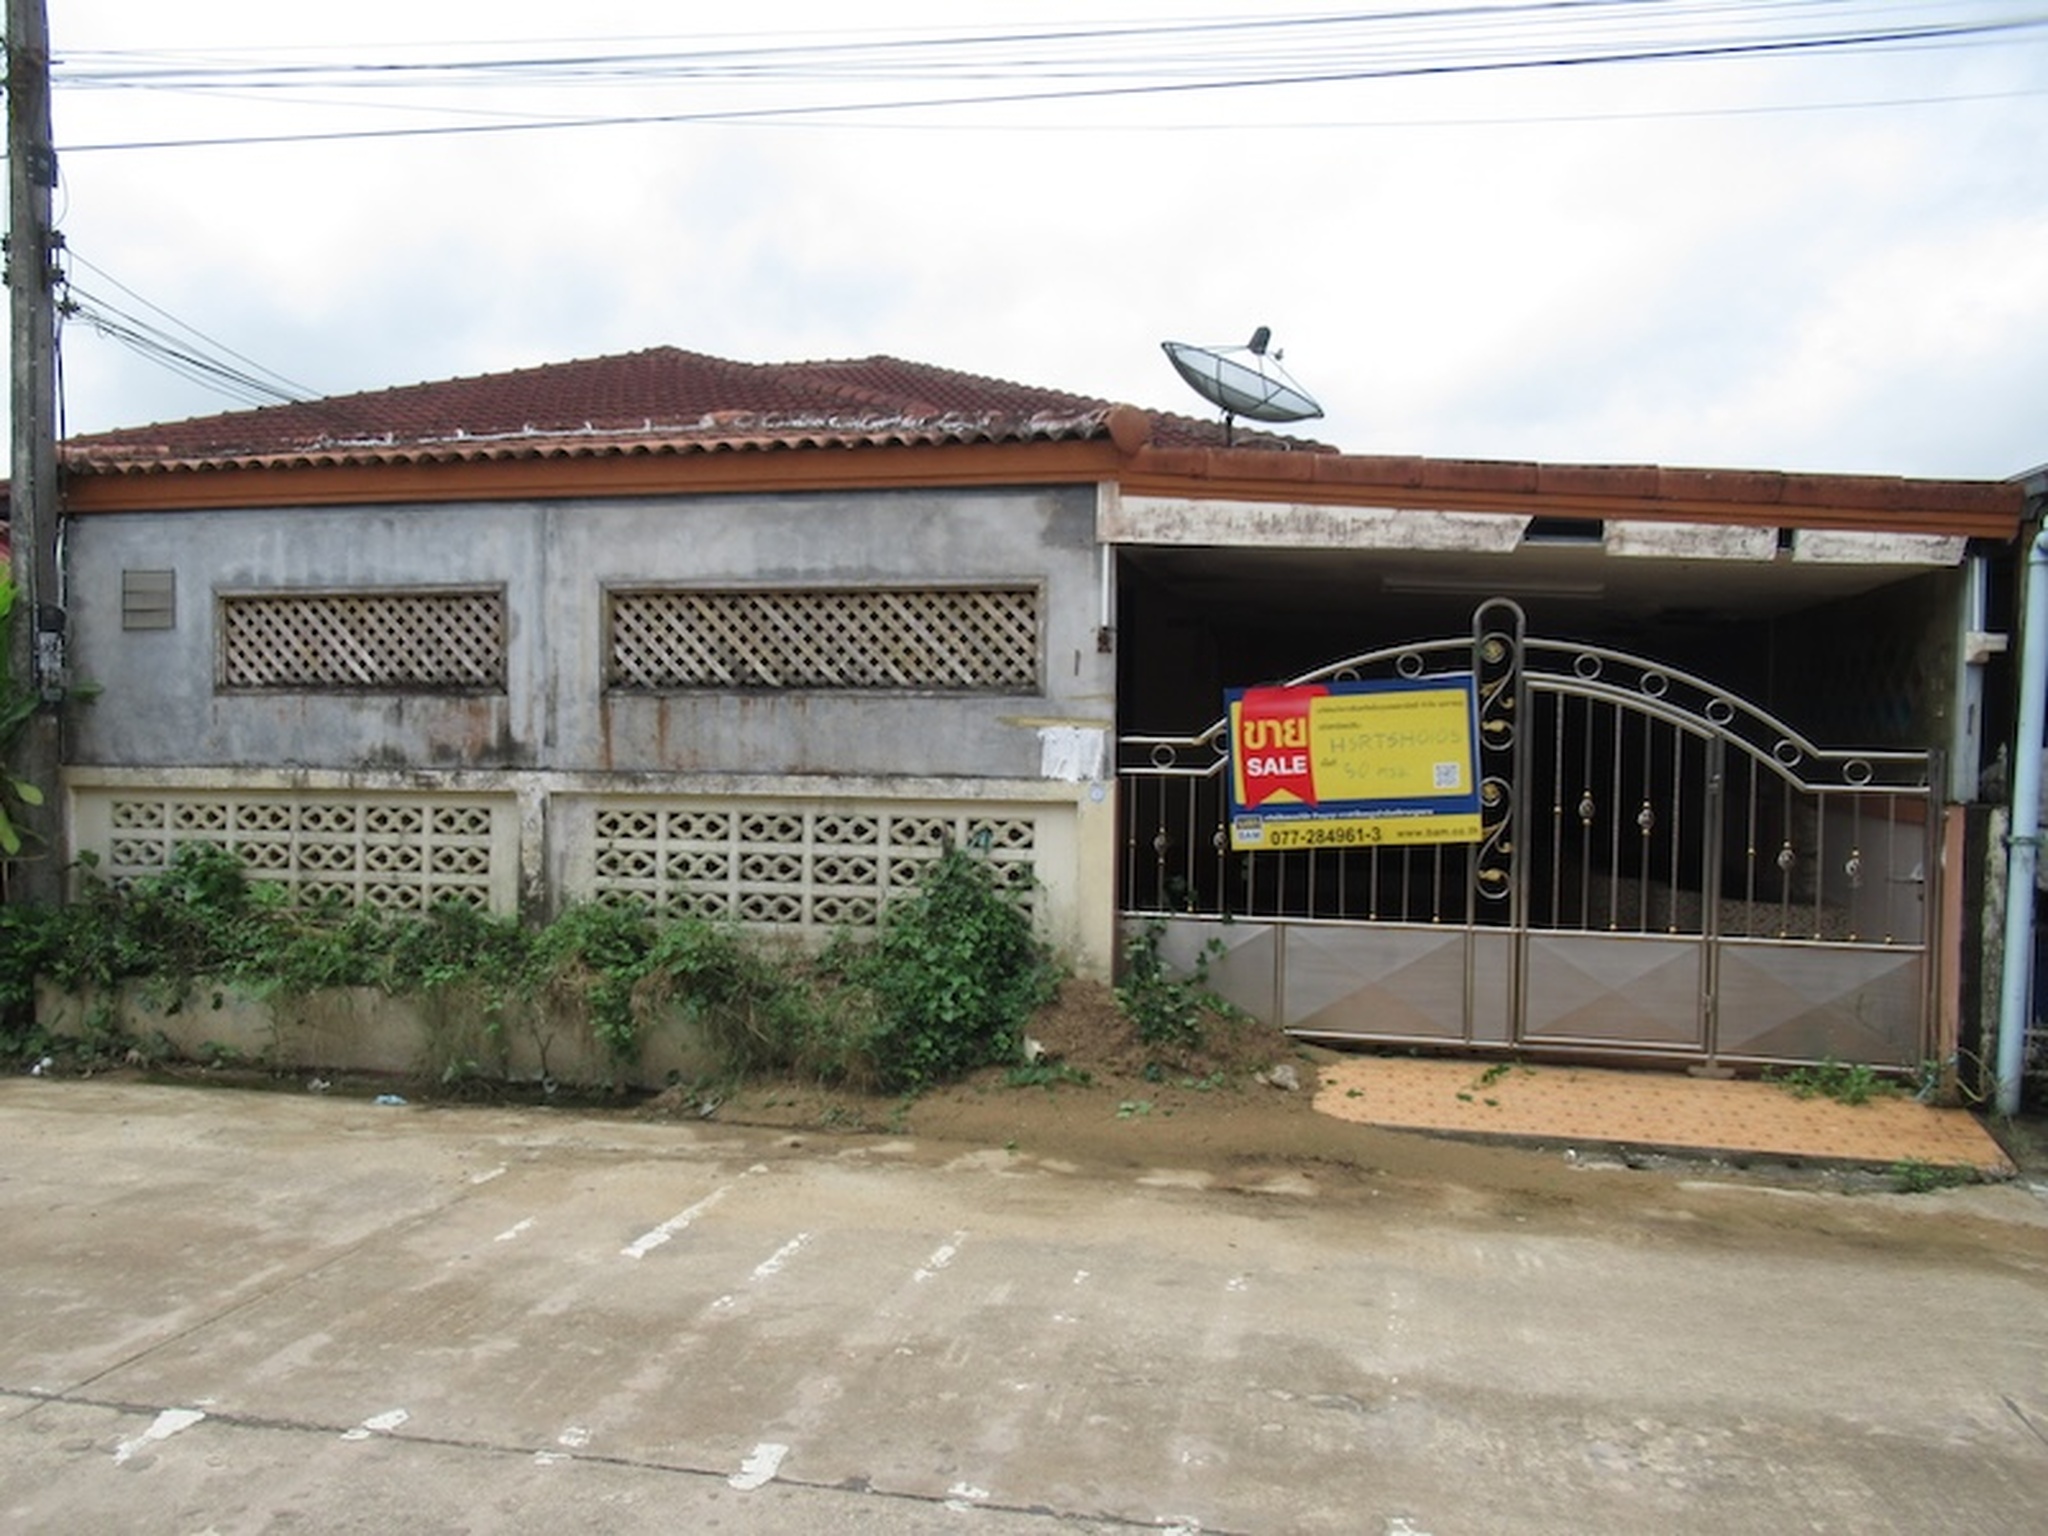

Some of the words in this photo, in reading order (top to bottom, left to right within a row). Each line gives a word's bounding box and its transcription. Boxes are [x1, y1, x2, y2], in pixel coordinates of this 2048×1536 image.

[1243, 717, 1307, 750] ขาย
[1246, 755, 1308, 777] SALE
[1270, 826, 1382, 846] 077-284961-3
